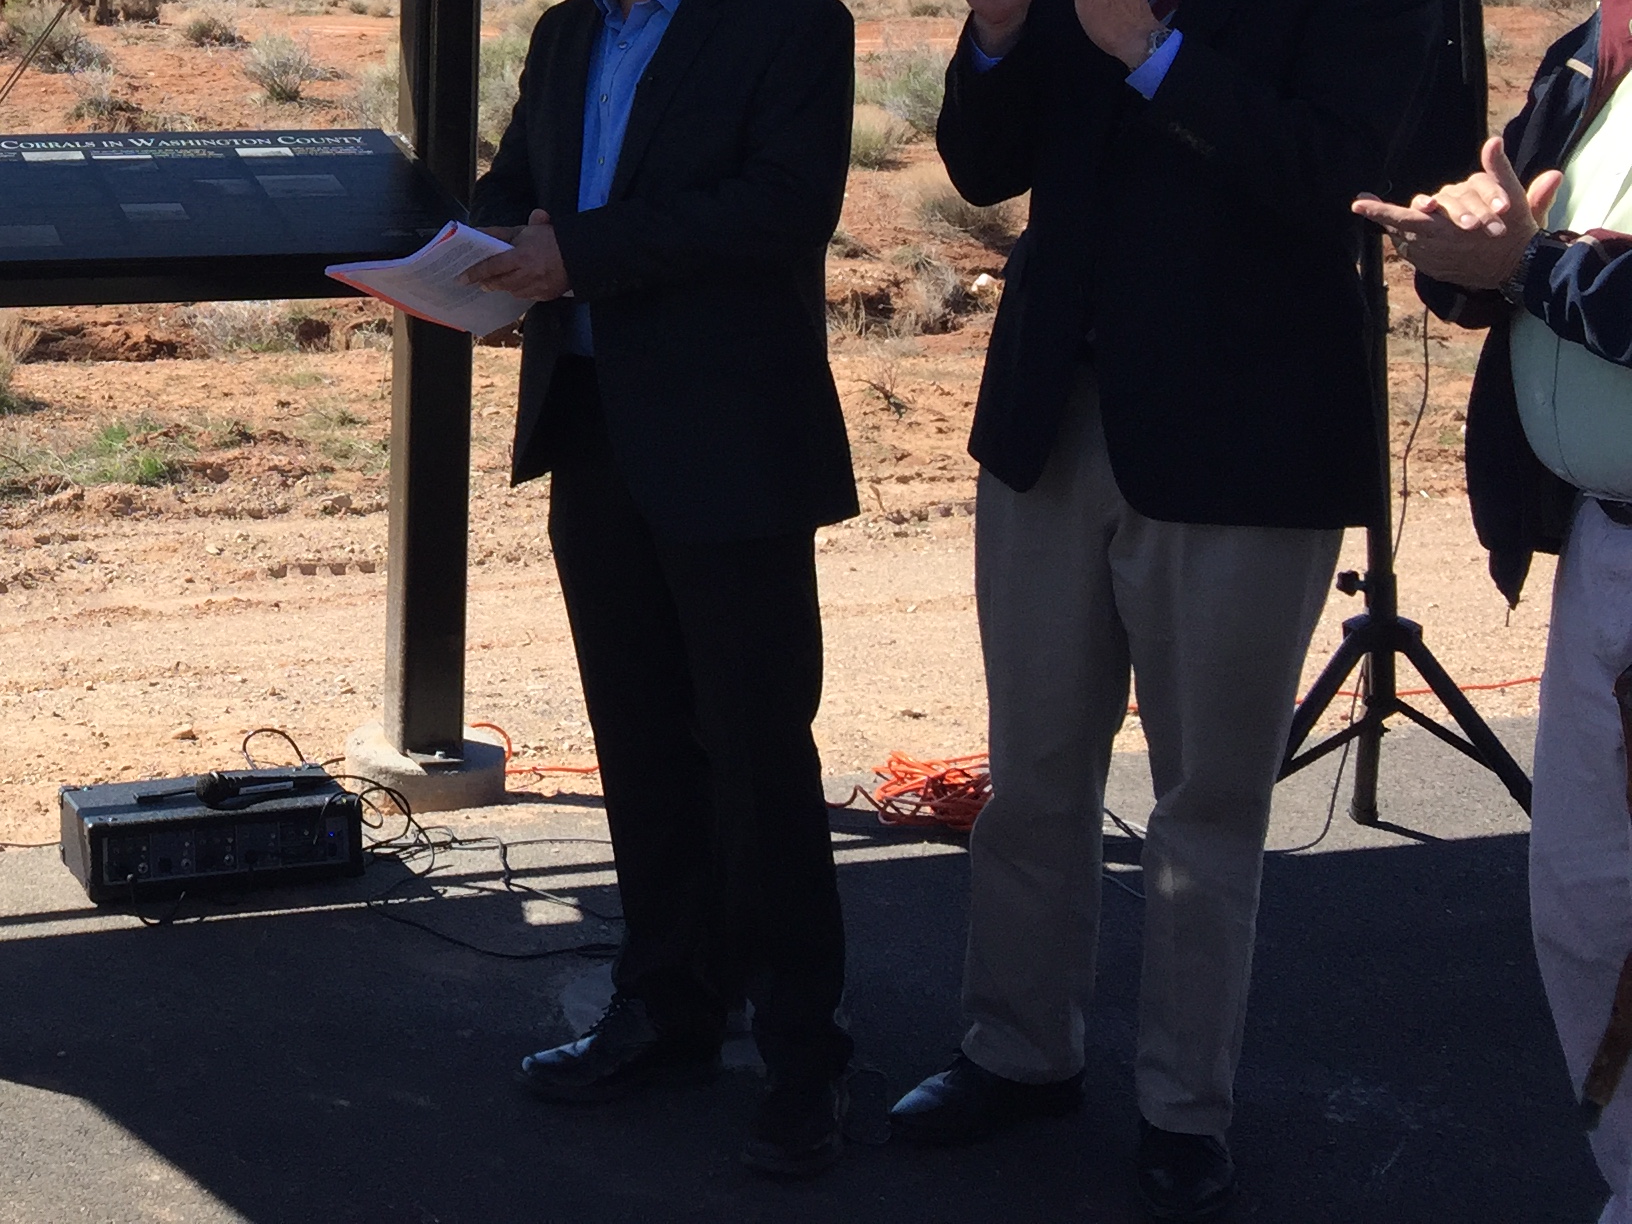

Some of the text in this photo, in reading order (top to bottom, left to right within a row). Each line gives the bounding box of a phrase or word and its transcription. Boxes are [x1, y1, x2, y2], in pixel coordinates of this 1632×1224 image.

[0, 140, 96, 150] CORRALS
[127, 138, 272, 147] WASHINGTON
[276, 135, 363, 145] COUNTY
